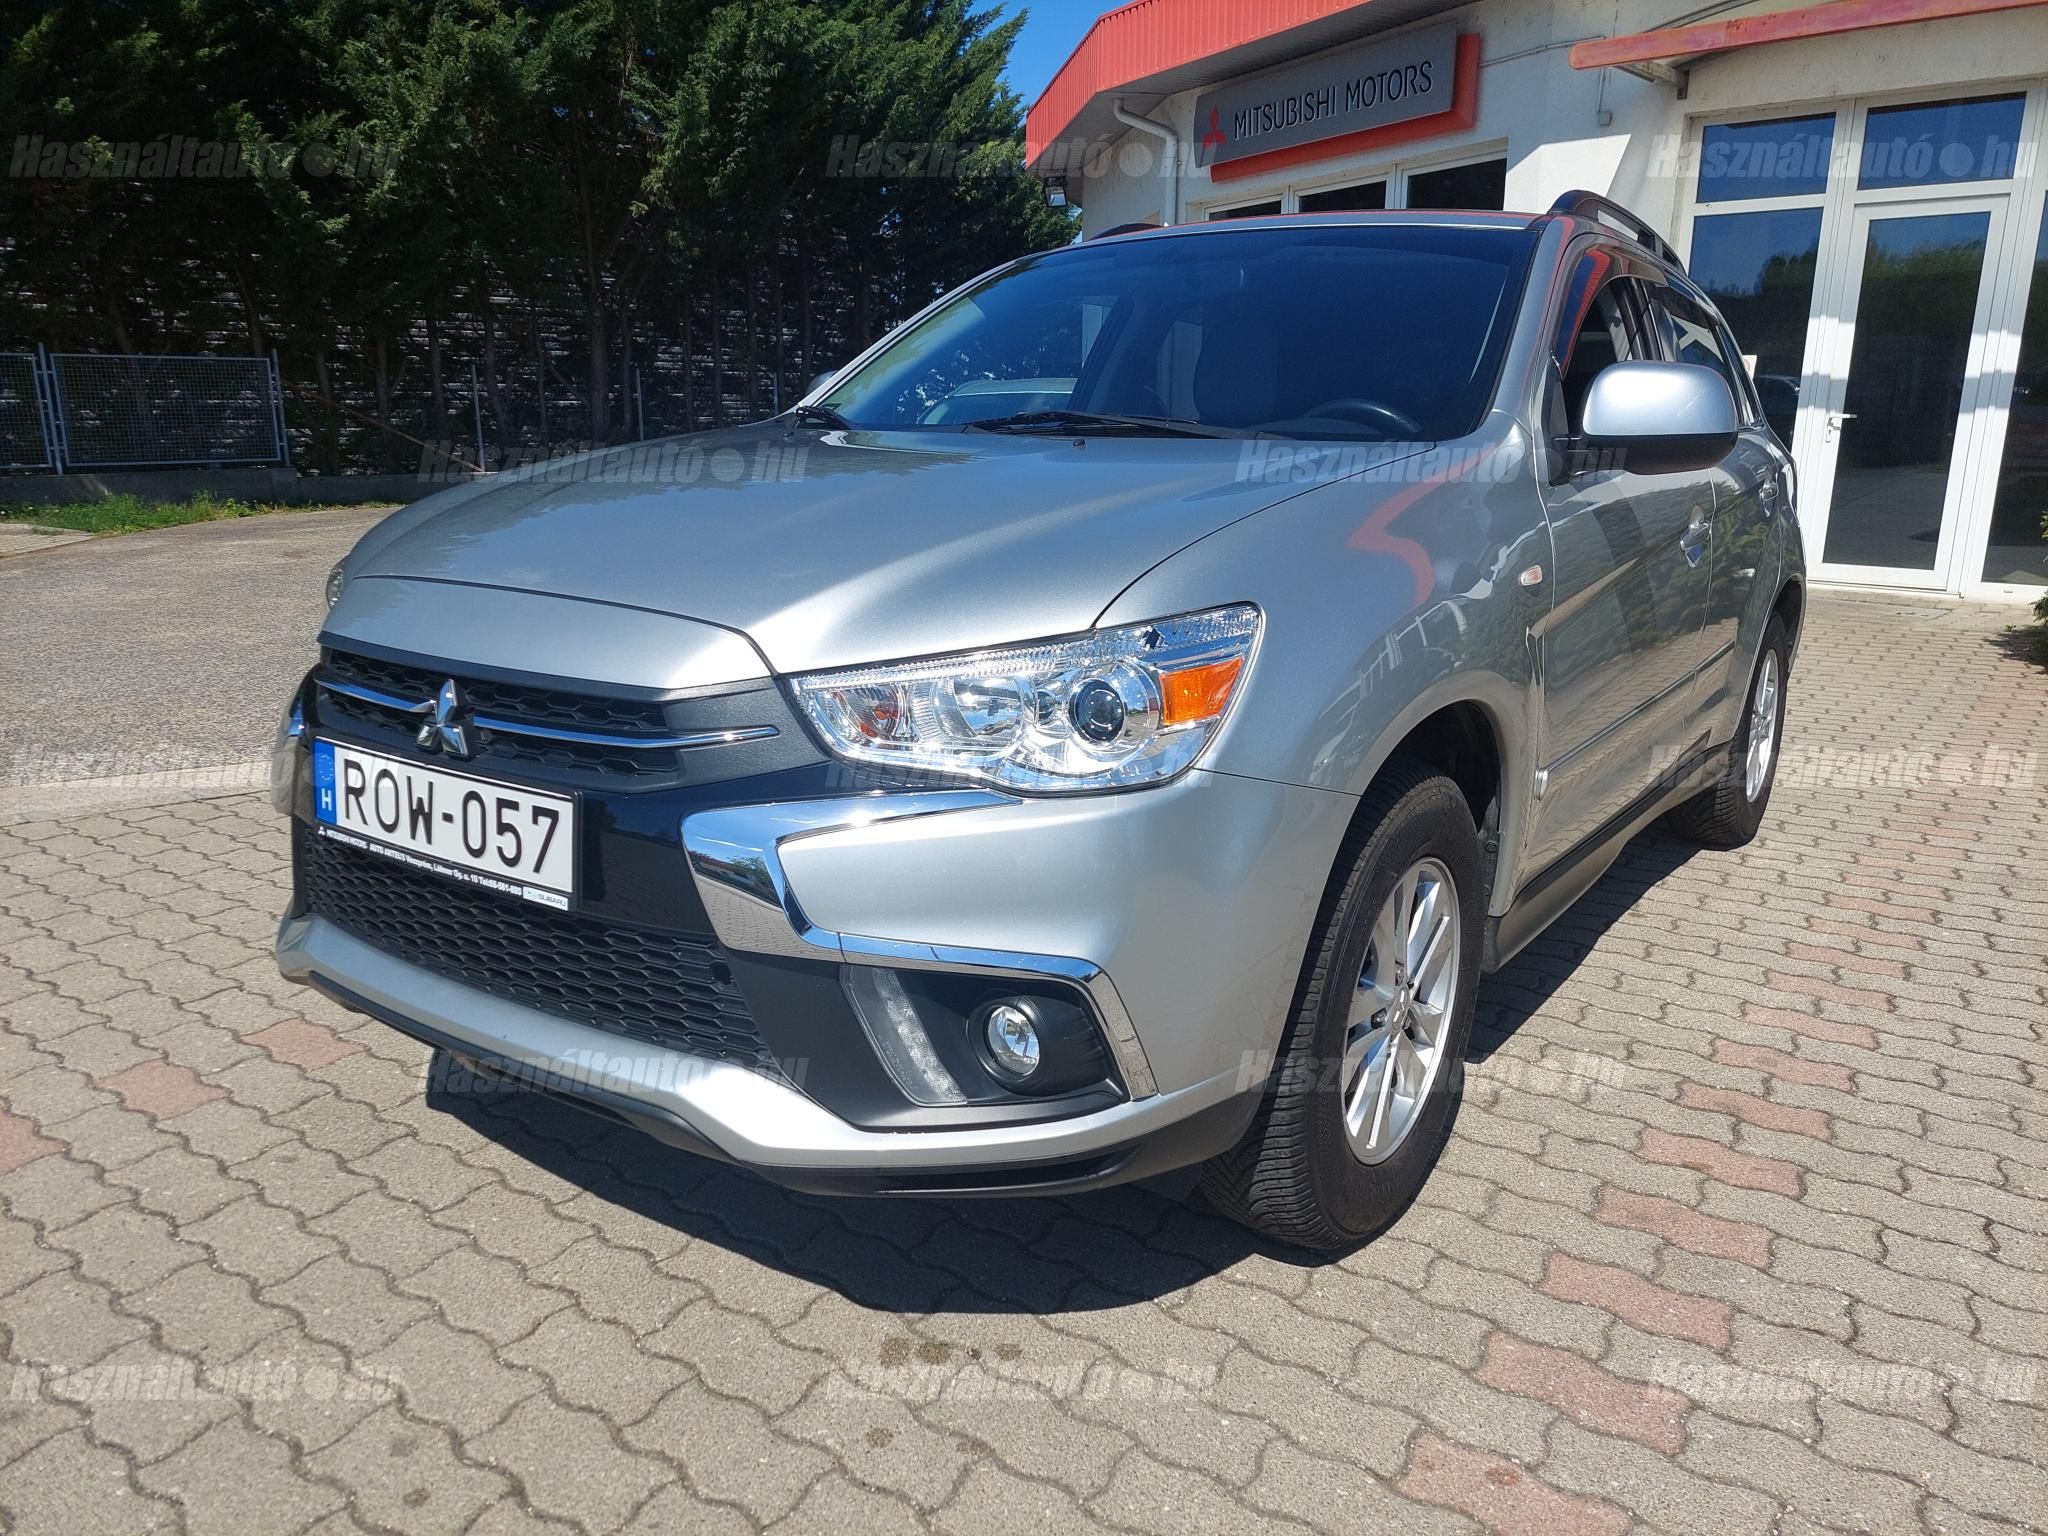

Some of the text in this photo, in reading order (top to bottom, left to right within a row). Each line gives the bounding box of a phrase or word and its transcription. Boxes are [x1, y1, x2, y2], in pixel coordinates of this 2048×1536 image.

[1234, 60, 1433, 140] MITSUBISHI MOTORS
[321, 788, 332, 811] H
[344, 758, 559, 874] ROW-057
